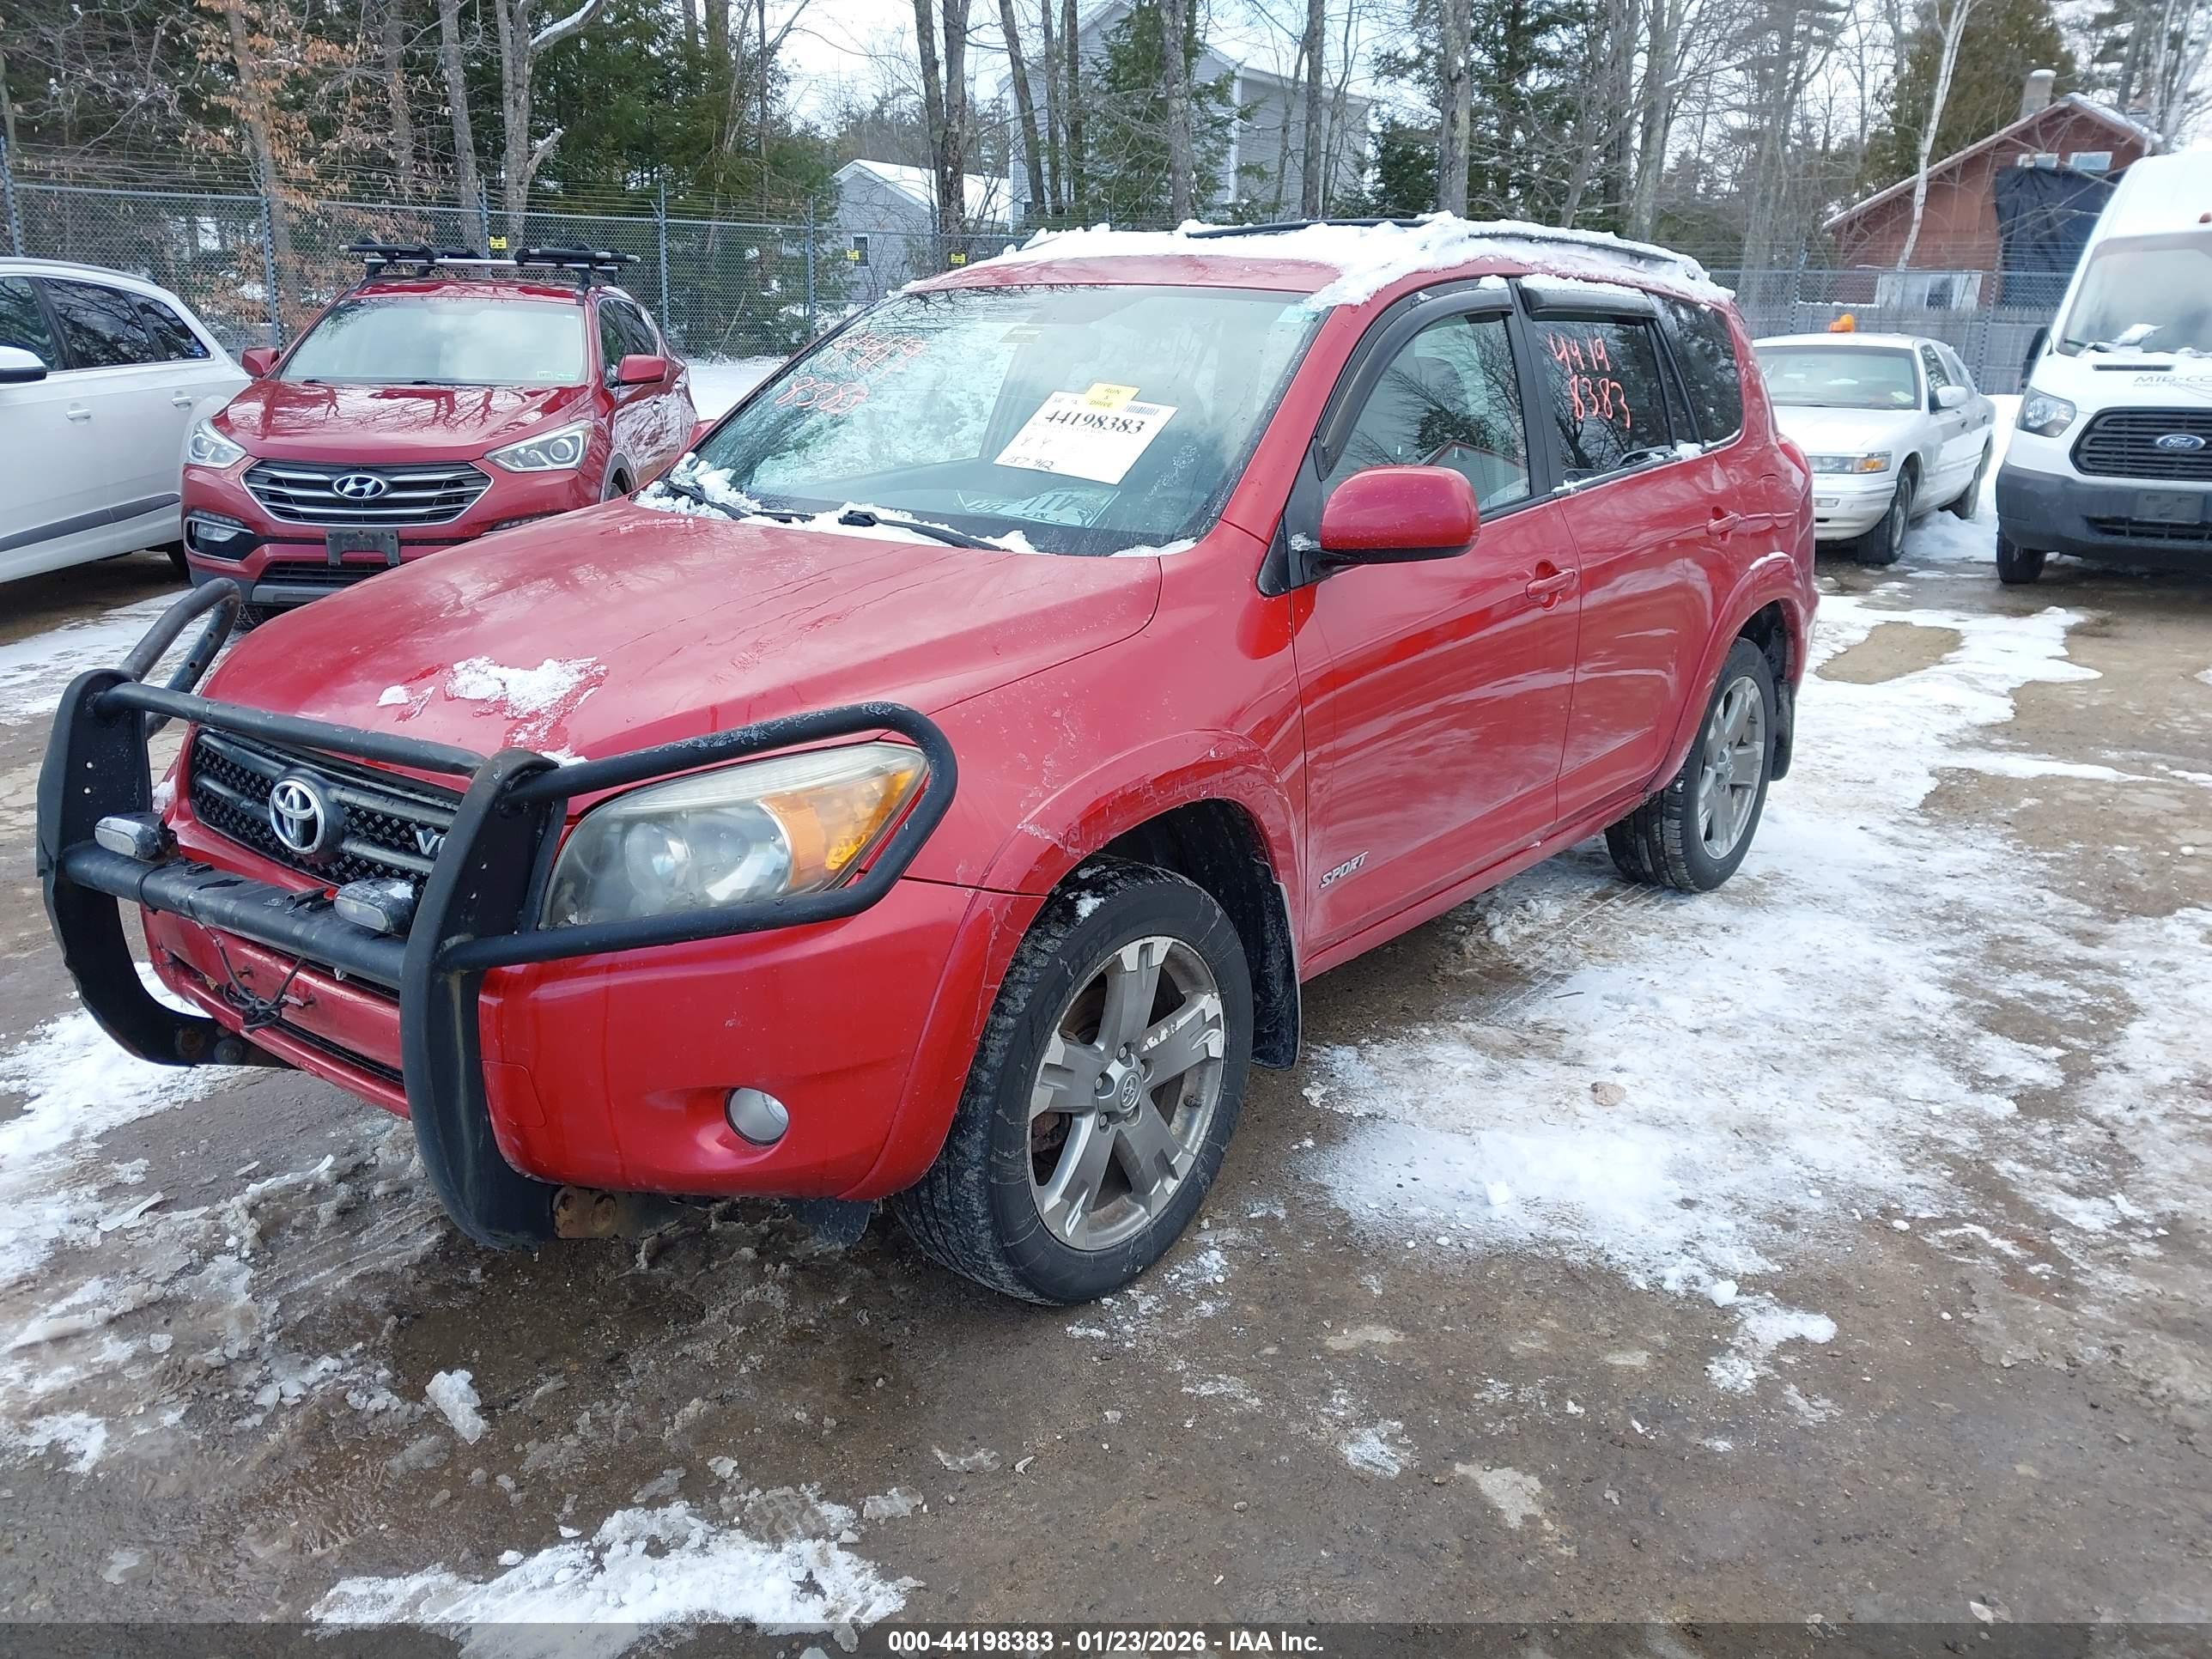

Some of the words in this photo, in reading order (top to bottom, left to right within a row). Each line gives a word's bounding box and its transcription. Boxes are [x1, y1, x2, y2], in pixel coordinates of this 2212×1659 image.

[1549, 332, 1611, 374] 4419
[1569, 374, 1631, 429] 8383
[1044, 410, 1146, 434] 44198383
[1319, 850, 1370, 889] SPORT
